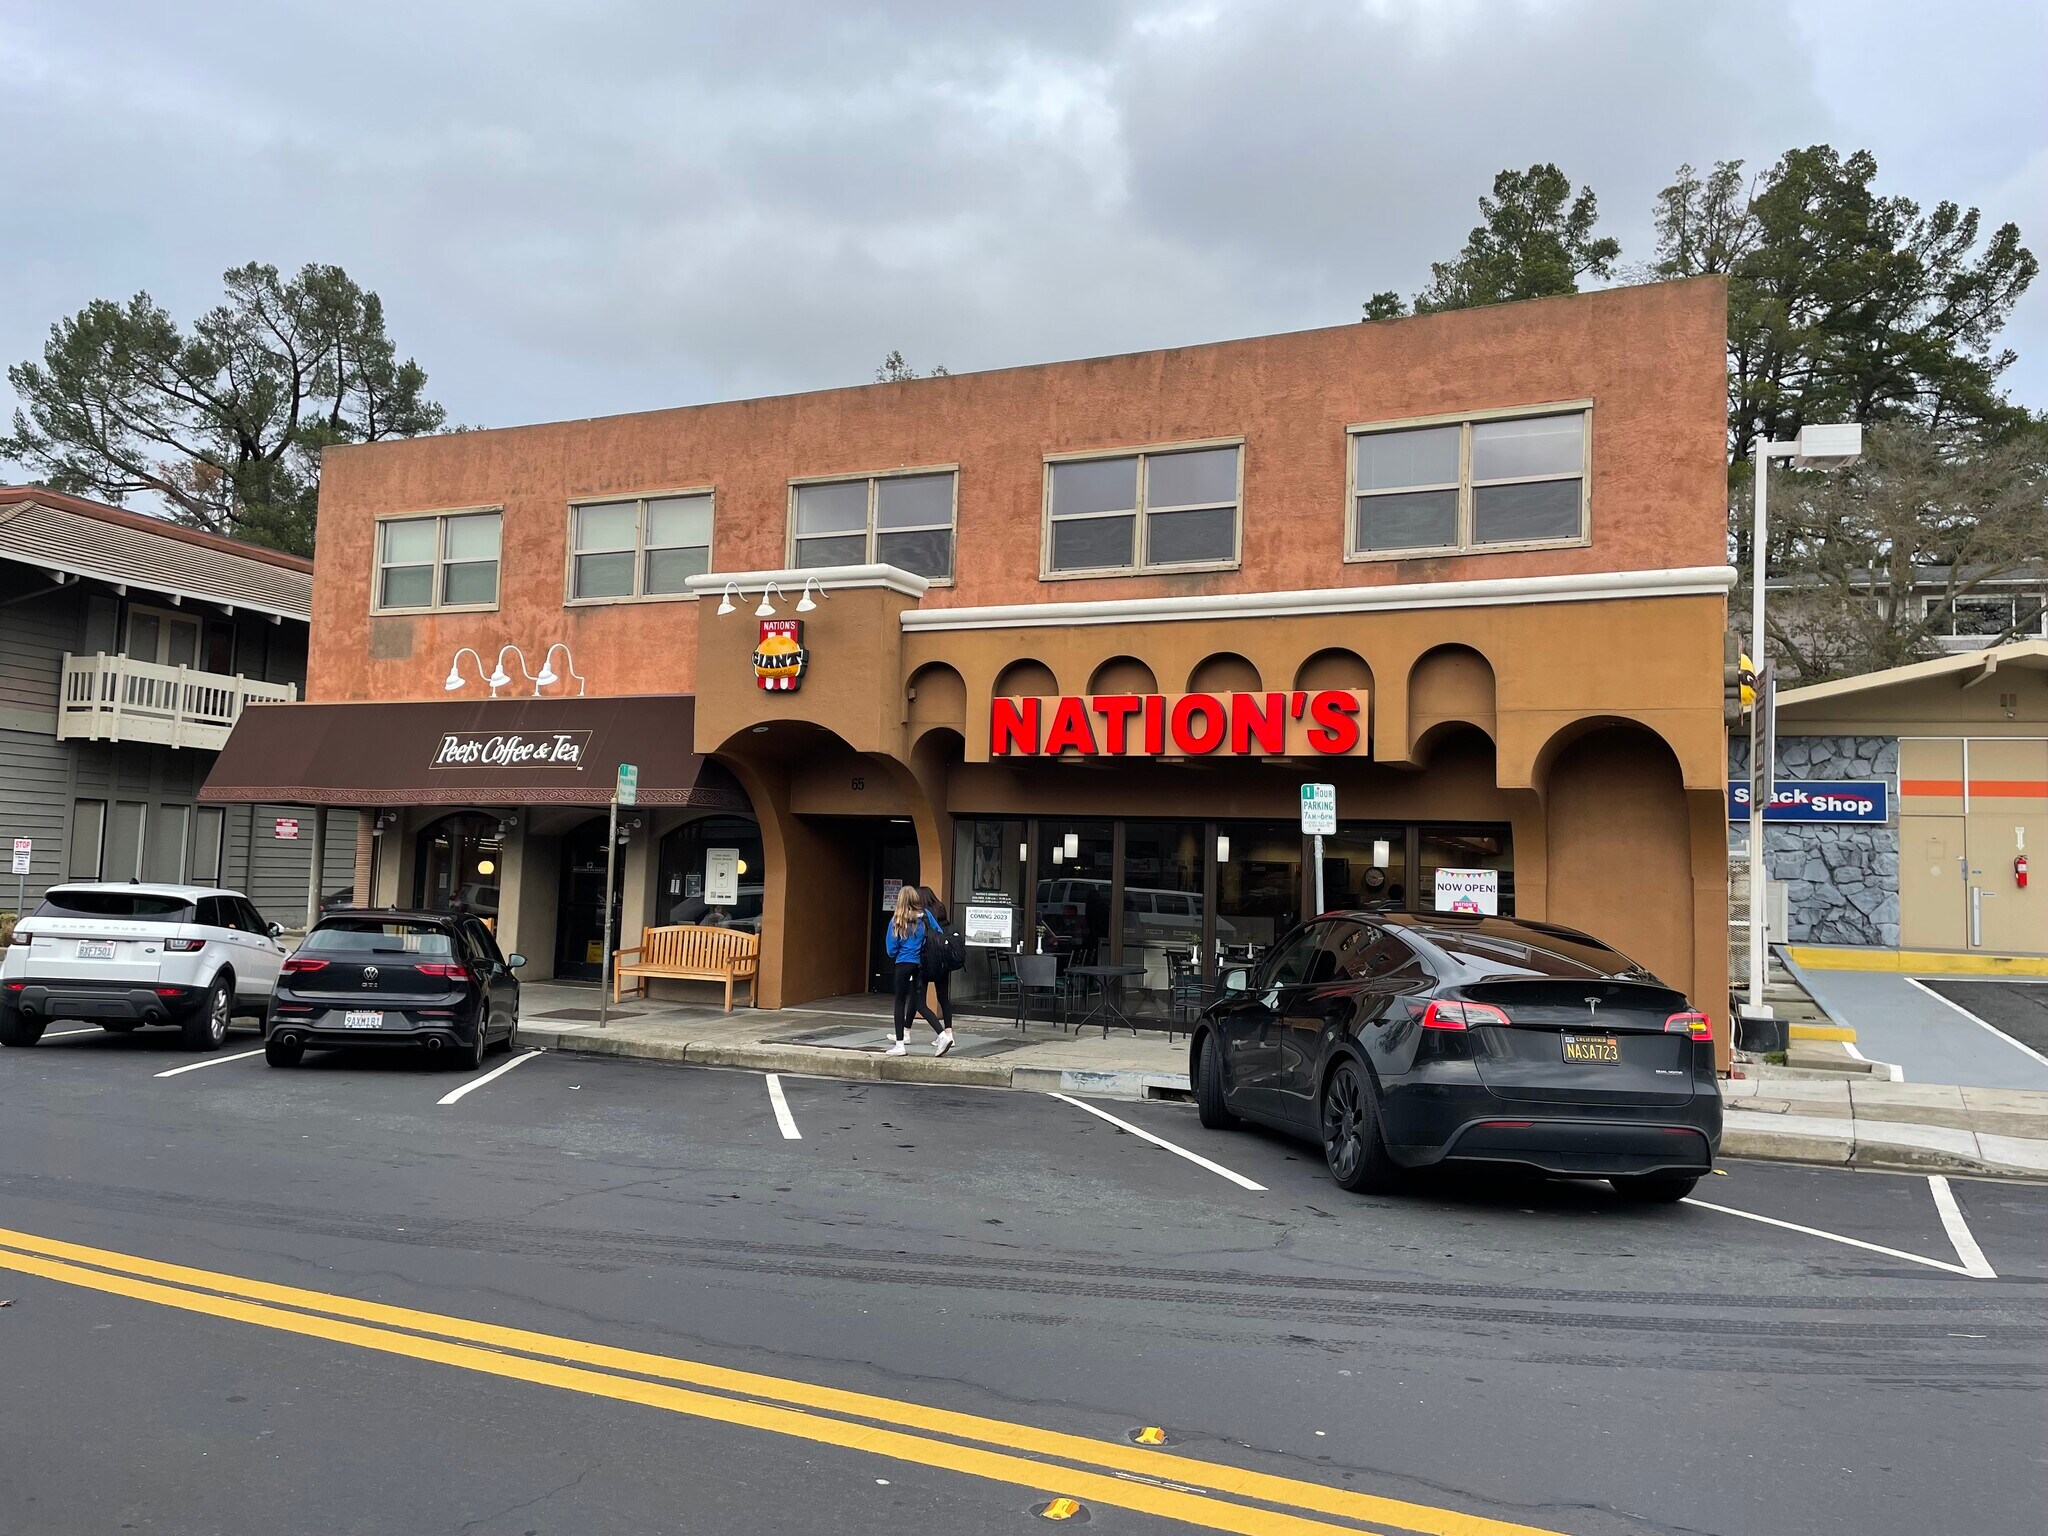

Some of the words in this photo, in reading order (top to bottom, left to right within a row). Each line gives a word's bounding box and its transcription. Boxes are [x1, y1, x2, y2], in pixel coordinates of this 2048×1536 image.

[764, 621, 796, 630] NATION'S
[752, 650, 803, 669] GIANT
[992, 690, 1360, 754] NATION'S
[436, 736, 483, 763] Peet's
[481, 736, 535, 766] Coffee
[533, 743, 551, 759] &
[548, 735, 580, 763] Tea
[851, 777, 865, 791] 65
[1314, 789, 1333, 798] HOUR
[1303, 801, 1334, 811] PARKING
[1734, 788, 1809, 804] Sack
[1811, 796, 1873, 816] Shop
[15, 841, 31, 849] STOP
[1437, 883, 1463, 891] NOW
[1464, 884, 1496, 893] OPEN!
[1566, 1044, 1618, 1060] NASA723
